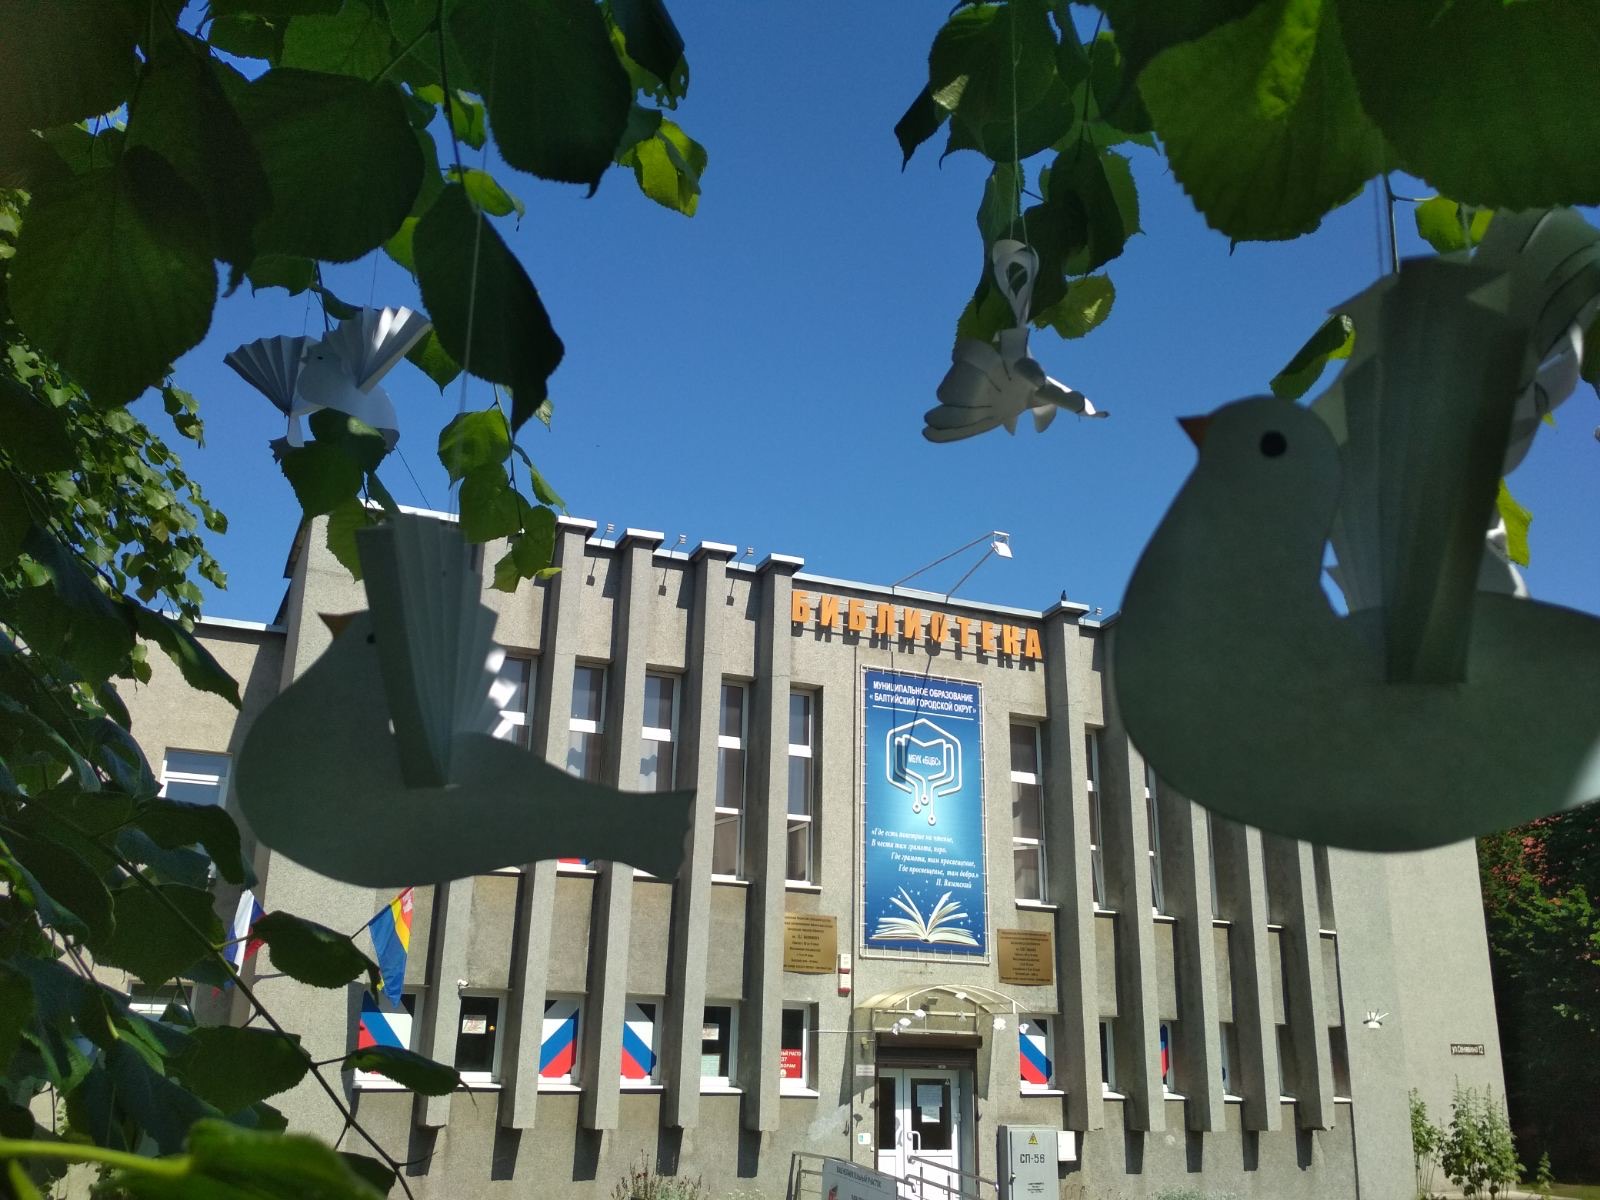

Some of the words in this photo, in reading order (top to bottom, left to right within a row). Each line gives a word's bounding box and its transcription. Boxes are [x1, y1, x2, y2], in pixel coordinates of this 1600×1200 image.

[791, 590, 1042, 660] БИБЛИОТЕКА
[873, 681, 928, 696] МУНИЦИПАЛЬНОЕ
[930, 688, 974, 702] ОБРАЗОВАНИЕ
[916, 698, 953, 710] ГОРОДСКОЙ
